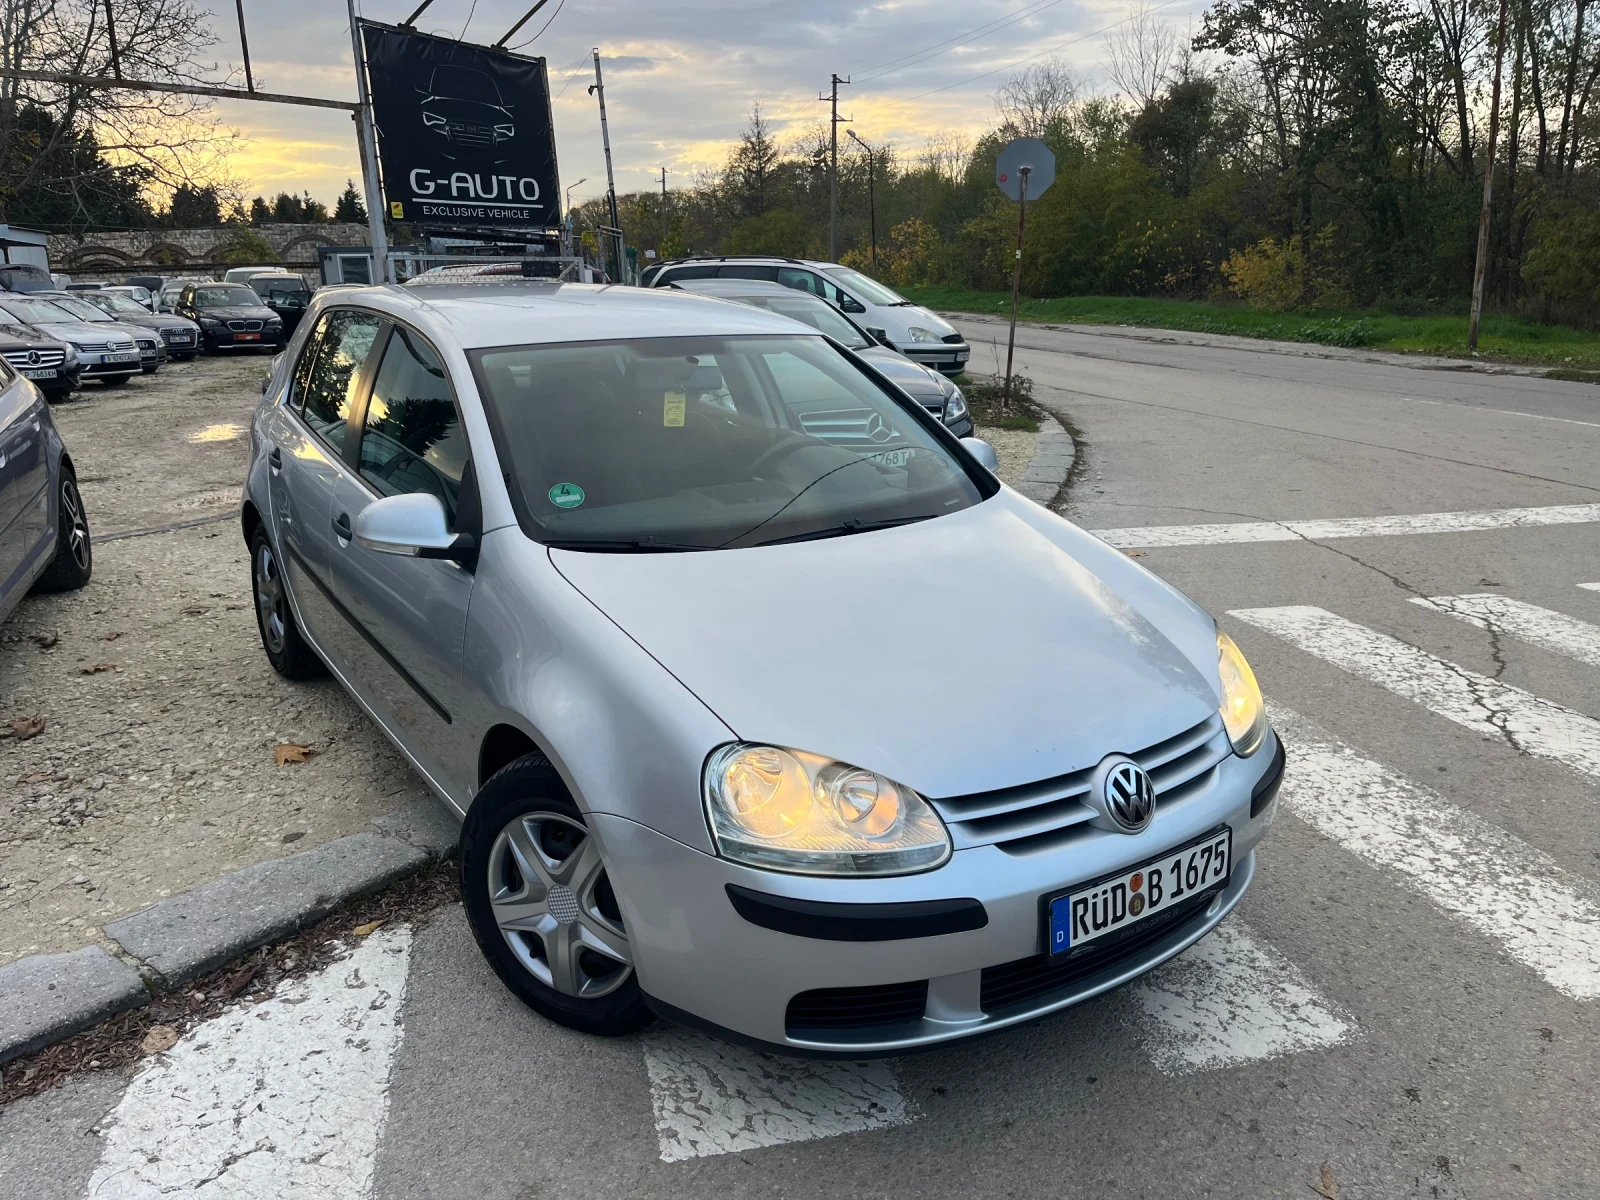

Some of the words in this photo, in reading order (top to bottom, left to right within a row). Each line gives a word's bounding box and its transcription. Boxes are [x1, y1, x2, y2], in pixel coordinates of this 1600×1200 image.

[409, 168, 540, 201] G-AUTO
[423, 205, 485, 217] EXCLUSIVE
[487, 209, 530, 219] VEHICLE
[561, 485, 571, 495] 4
[1056, 930, 1064, 943] D
[1072, 882, 1127, 940] RÜD
[1148, 868, 1163, 909] B
[1170, 838, 1226, 899] 1675
